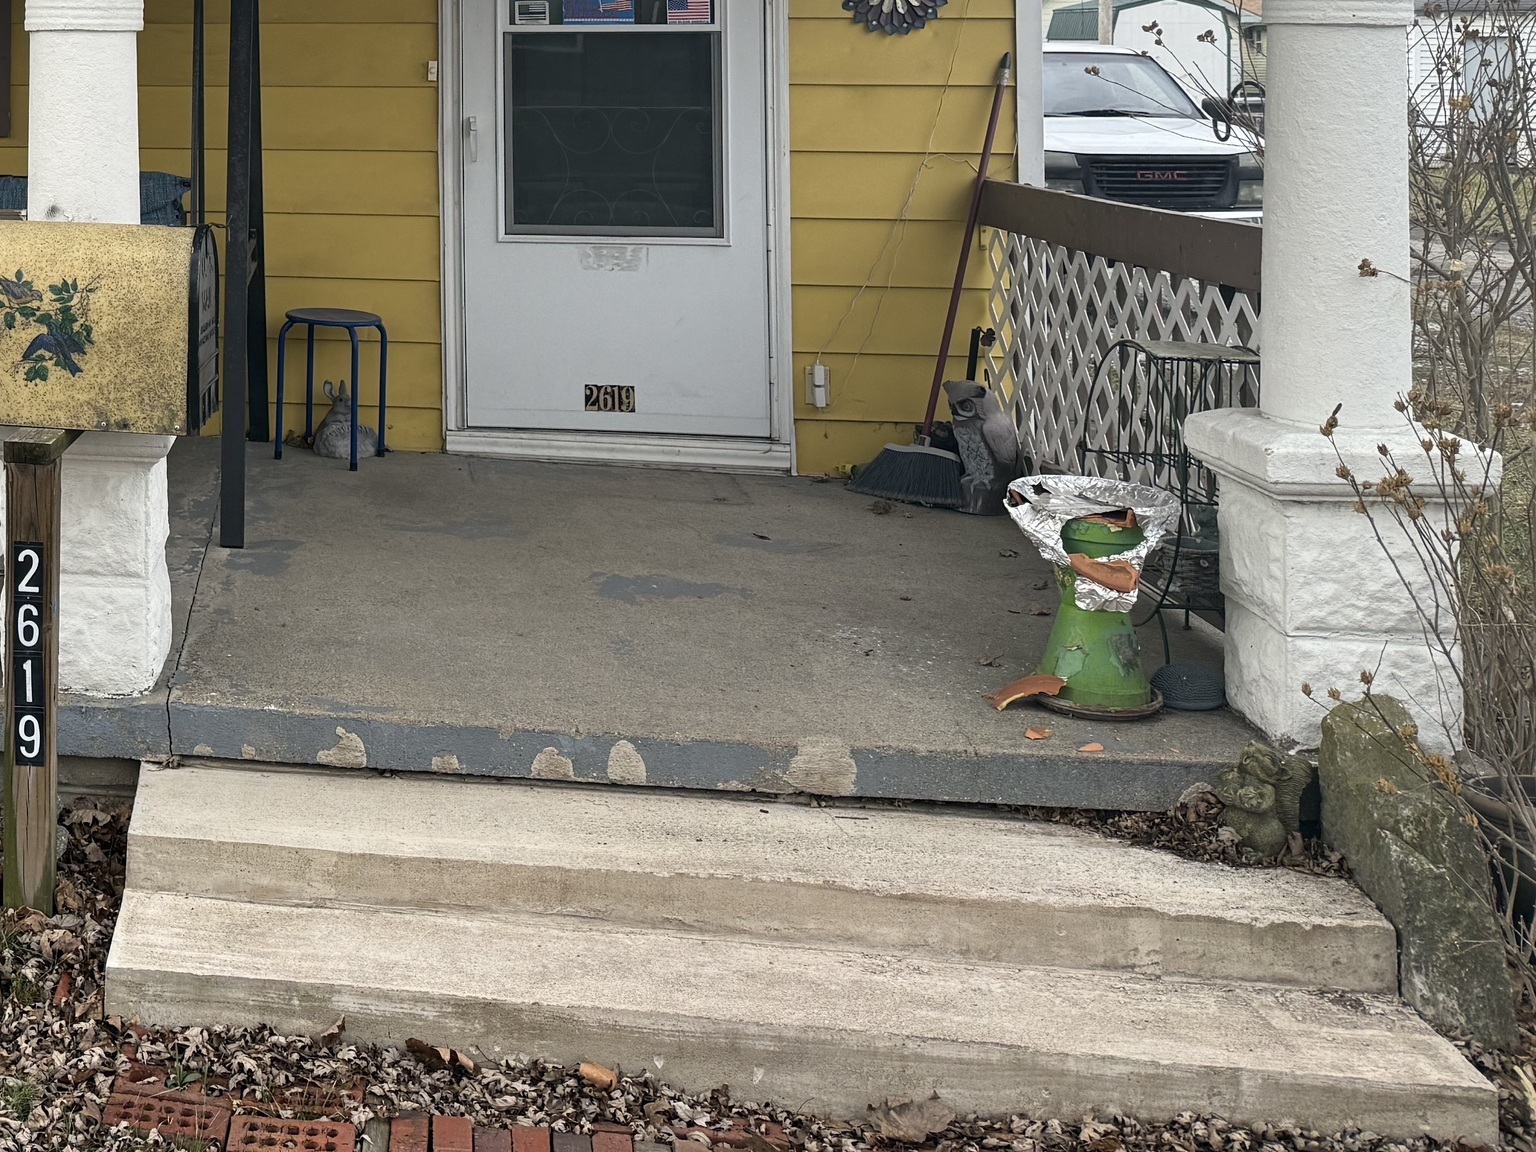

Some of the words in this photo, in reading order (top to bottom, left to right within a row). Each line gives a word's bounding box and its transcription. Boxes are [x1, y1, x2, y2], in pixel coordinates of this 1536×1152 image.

[1136, 170, 1187, 180] GMC
[585, 385, 635, 412] 2619
[17, 549, 41, 759] 2619
